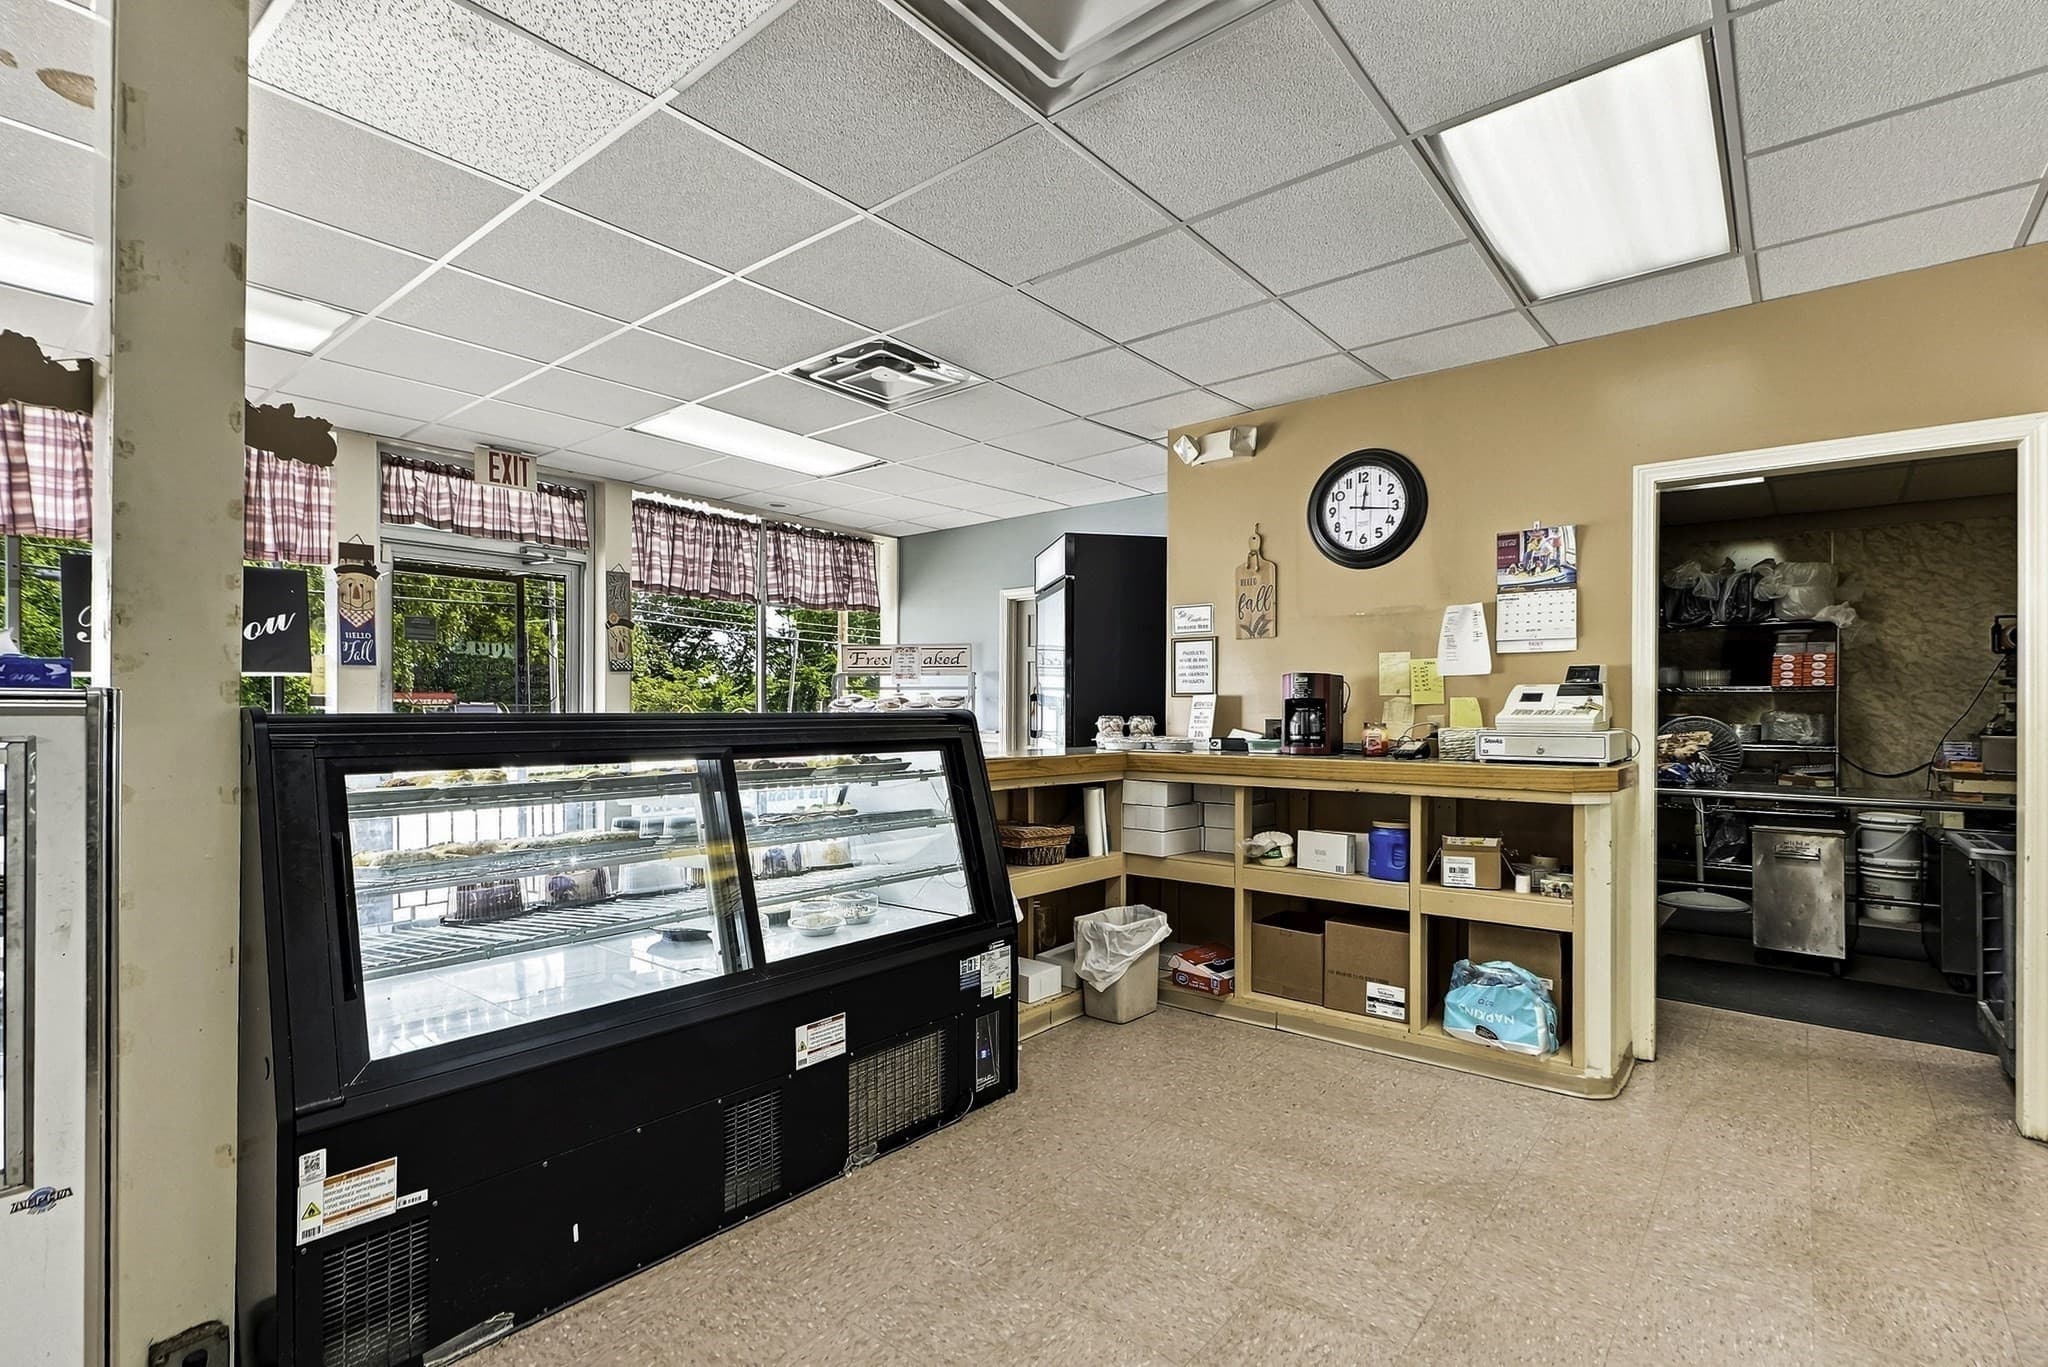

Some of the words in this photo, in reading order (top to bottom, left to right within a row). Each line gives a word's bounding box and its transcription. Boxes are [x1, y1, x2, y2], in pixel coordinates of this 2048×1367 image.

[489, 451, 530, 487] EXIT
[1346, 478, 1352, 490] 11
[1358, 472, 1369, 484] 12
[1387, 483, 1395, 495] 2
[1332, 491, 1346, 502] 10
[1392, 499, 1400, 510] 3
[1328, 507, 1337, 518] 9
[1385, 514, 1395, 526] 4
[1334, 522, 1341, 533] 8
[1375, 527, 1383, 539] 5
[1345, 530, 1353, 542] 7
[1359, 533, 1368, 544] 6
[1238, 584, 1274, 620] fall
[243, 612, 296, 641] ou
[345, 631, 372, 640] HELLO
[343, 639, 374, 664] Fall
[923, 650, 966, 666] aked
